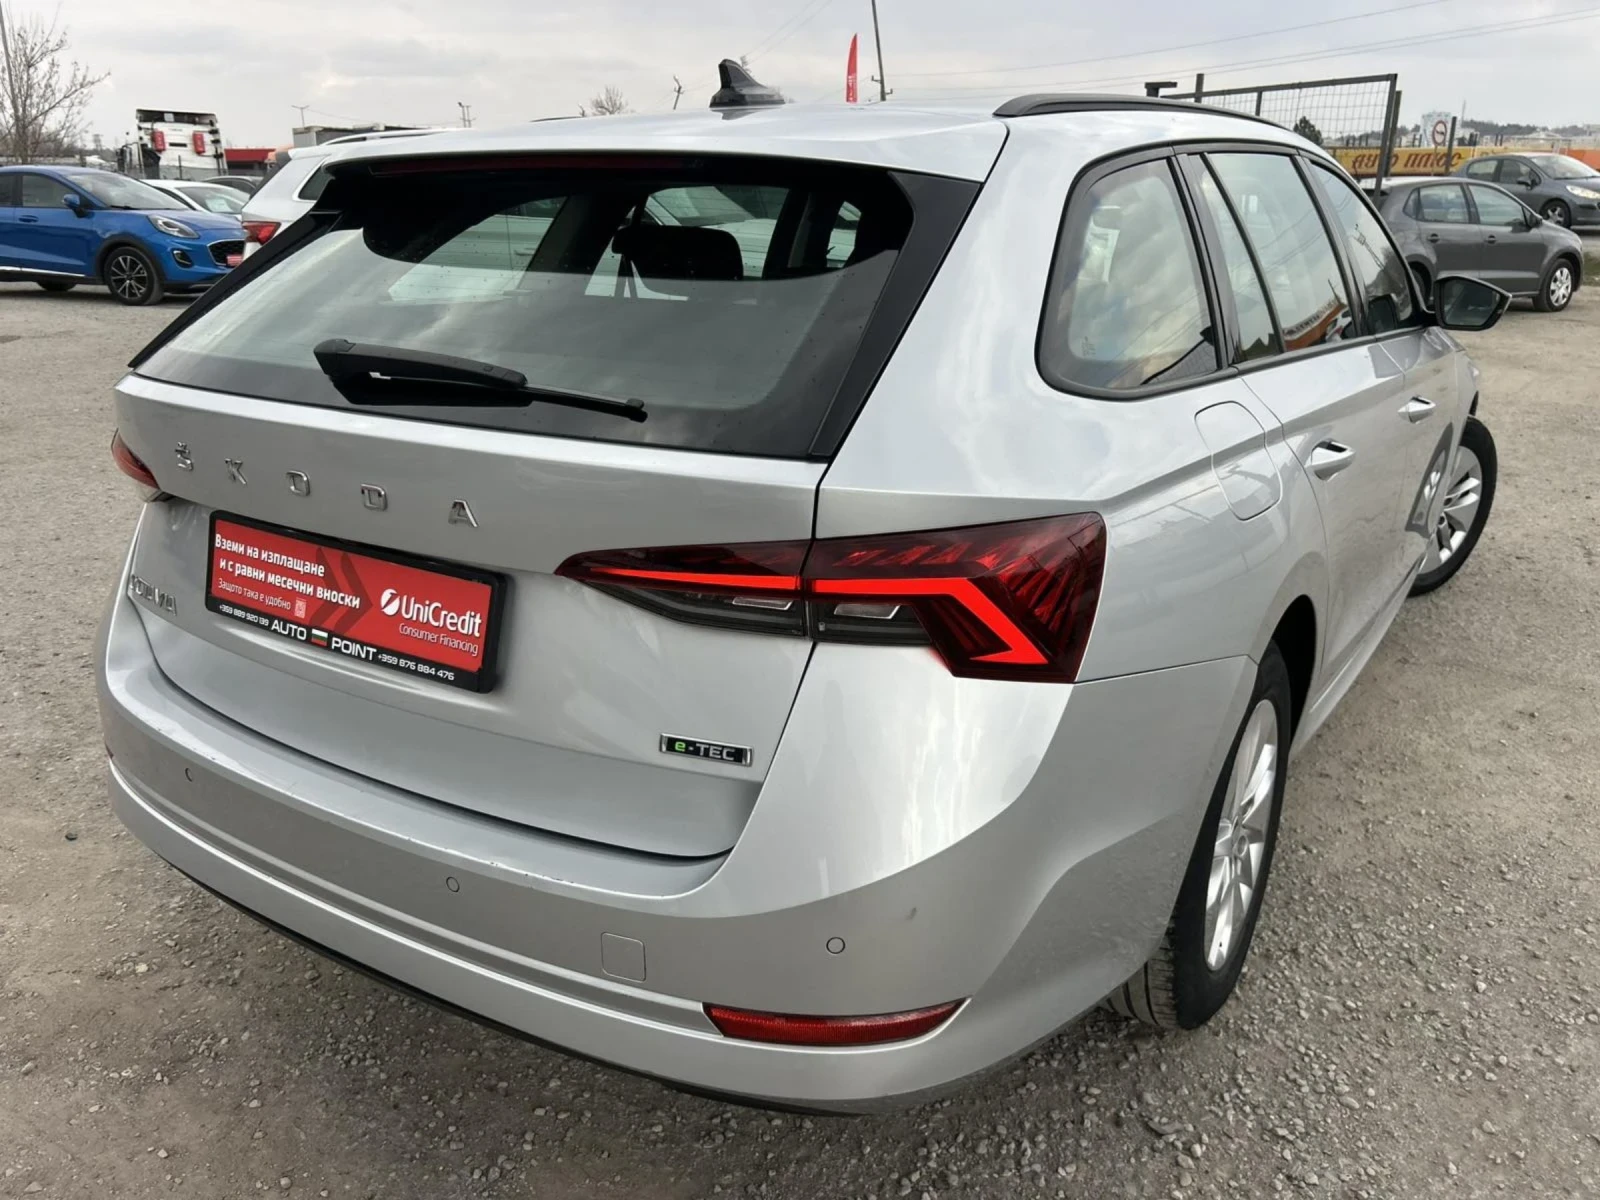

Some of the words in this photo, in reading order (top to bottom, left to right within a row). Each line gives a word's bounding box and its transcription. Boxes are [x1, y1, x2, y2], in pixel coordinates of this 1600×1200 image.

[215, 533, 245, 557] Вземи
[246, 545, 259, 559] на
[261, 550, 325, 577] изплащане
[218, 577, 243, 596] Защото
[243, 587, 259, 600] така
[260, 594, 265, 602] е
[265, 594, 291, 610] удобно
[219, 558, 227, 570] и
[227, 560, 233, 571] с
[235, 562, 265, 582] равни
[267, 573, 314, 596] месечни
[316, 586, 361, 609] вноски
[219, 604, 233, 615] +359
[401, 594, 482, 638] UniCredit
[271, 619, 307, 641] AUTO
[399, 623, 439, 643] Consumer
[440, 633, 479, 657] Financing
[331, 636, 377, 661] POINT
[378, 653, 398, 666] +359
[399, 657, 416, 670] 876
[417, 663, 435, 676] 884
[437, 669, 455, 681] 476
[674, 741, 735, 761] e-TEC
